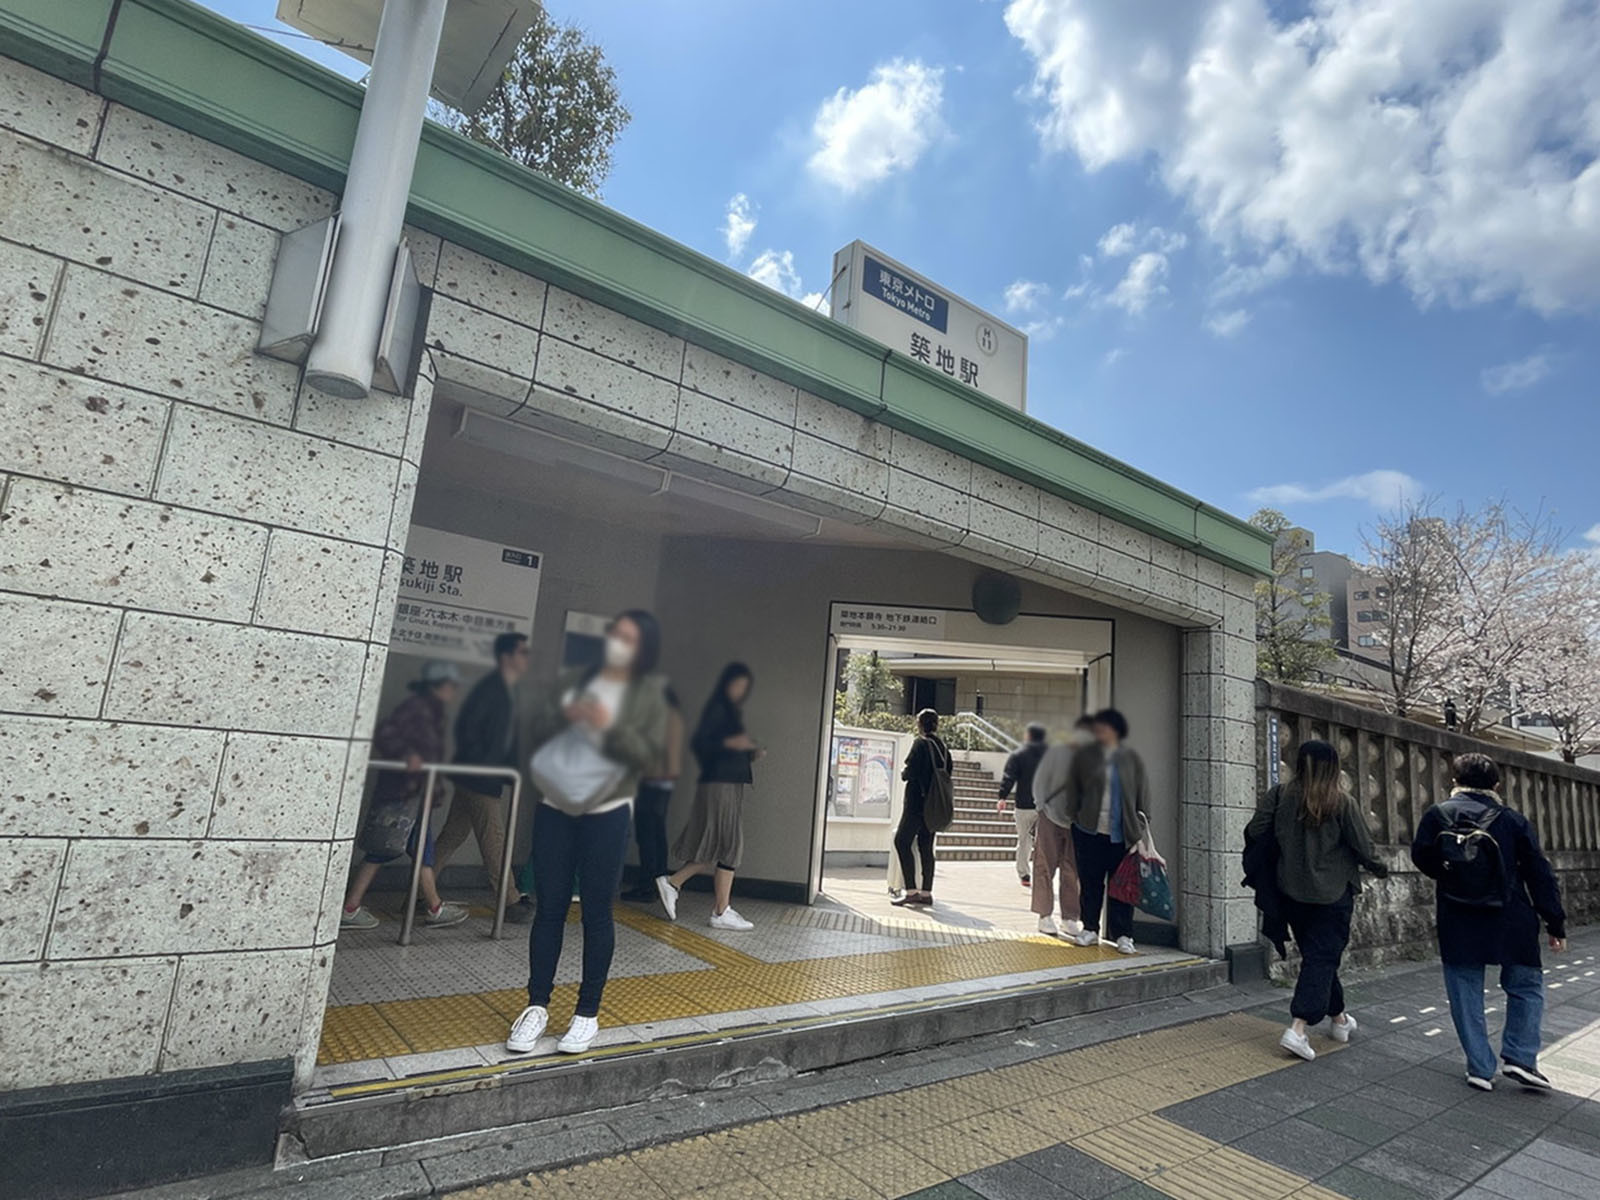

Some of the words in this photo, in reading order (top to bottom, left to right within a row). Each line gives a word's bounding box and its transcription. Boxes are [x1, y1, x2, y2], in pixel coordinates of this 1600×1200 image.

[879, 269, 935, 310] 東京メトロ
[882, 287, 906, 311] Tokyo
[907, 300, 931, 321] Metro
[909, 332, 979, 387] 築地駅
[527, 556, 533, 566] 1
[399, 578, 435, 594] sukiji
[438, 583, 463, 597] Sta.
